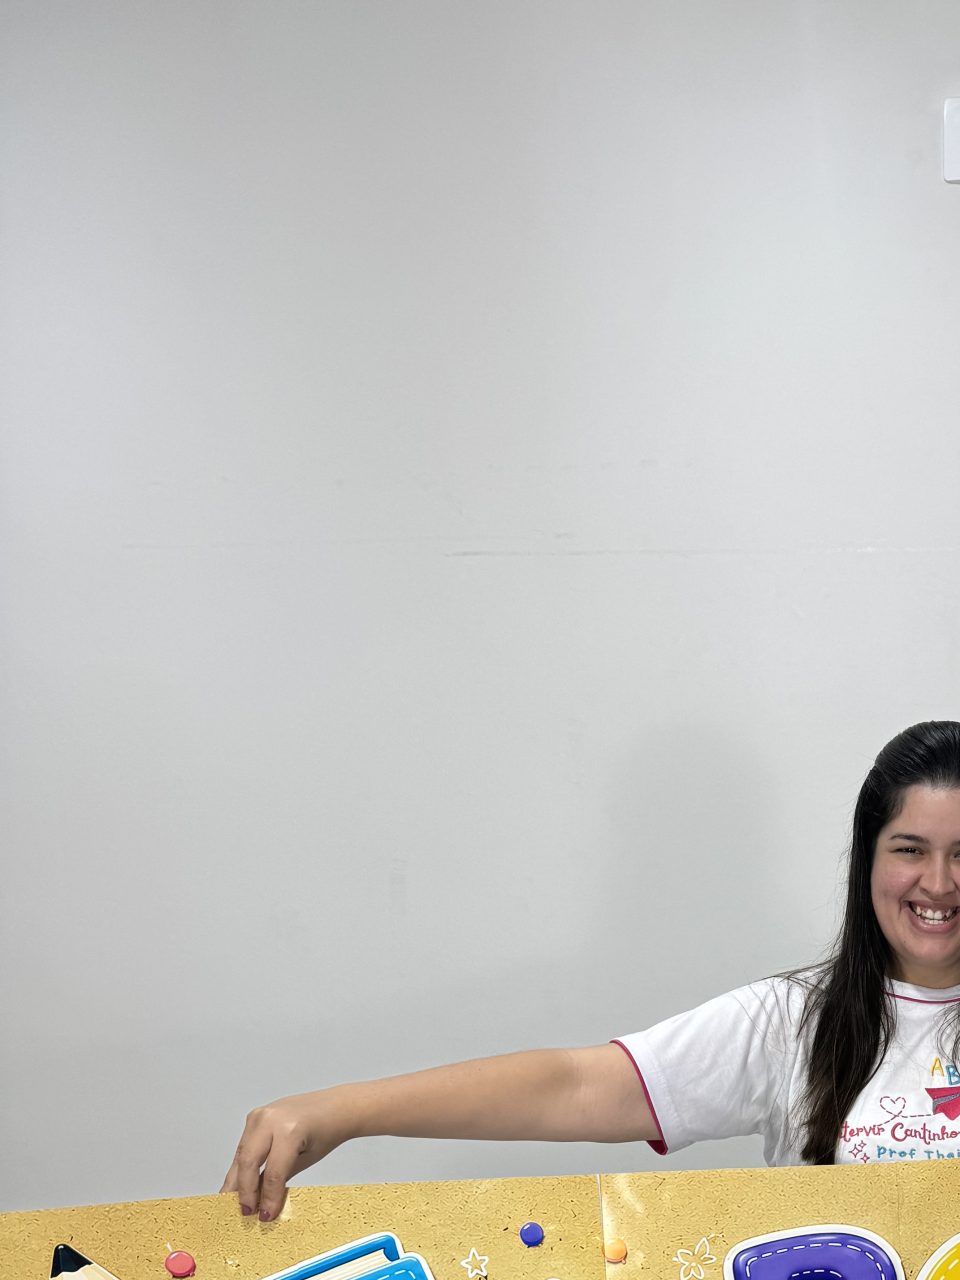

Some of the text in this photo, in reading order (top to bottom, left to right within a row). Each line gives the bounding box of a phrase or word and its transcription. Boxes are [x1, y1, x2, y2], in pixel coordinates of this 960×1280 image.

[839, 1121, 885, 1142] tervir
[891, 1121, 960, 1145] Cantinho
[877, 1144, 916, 1159] Prof
